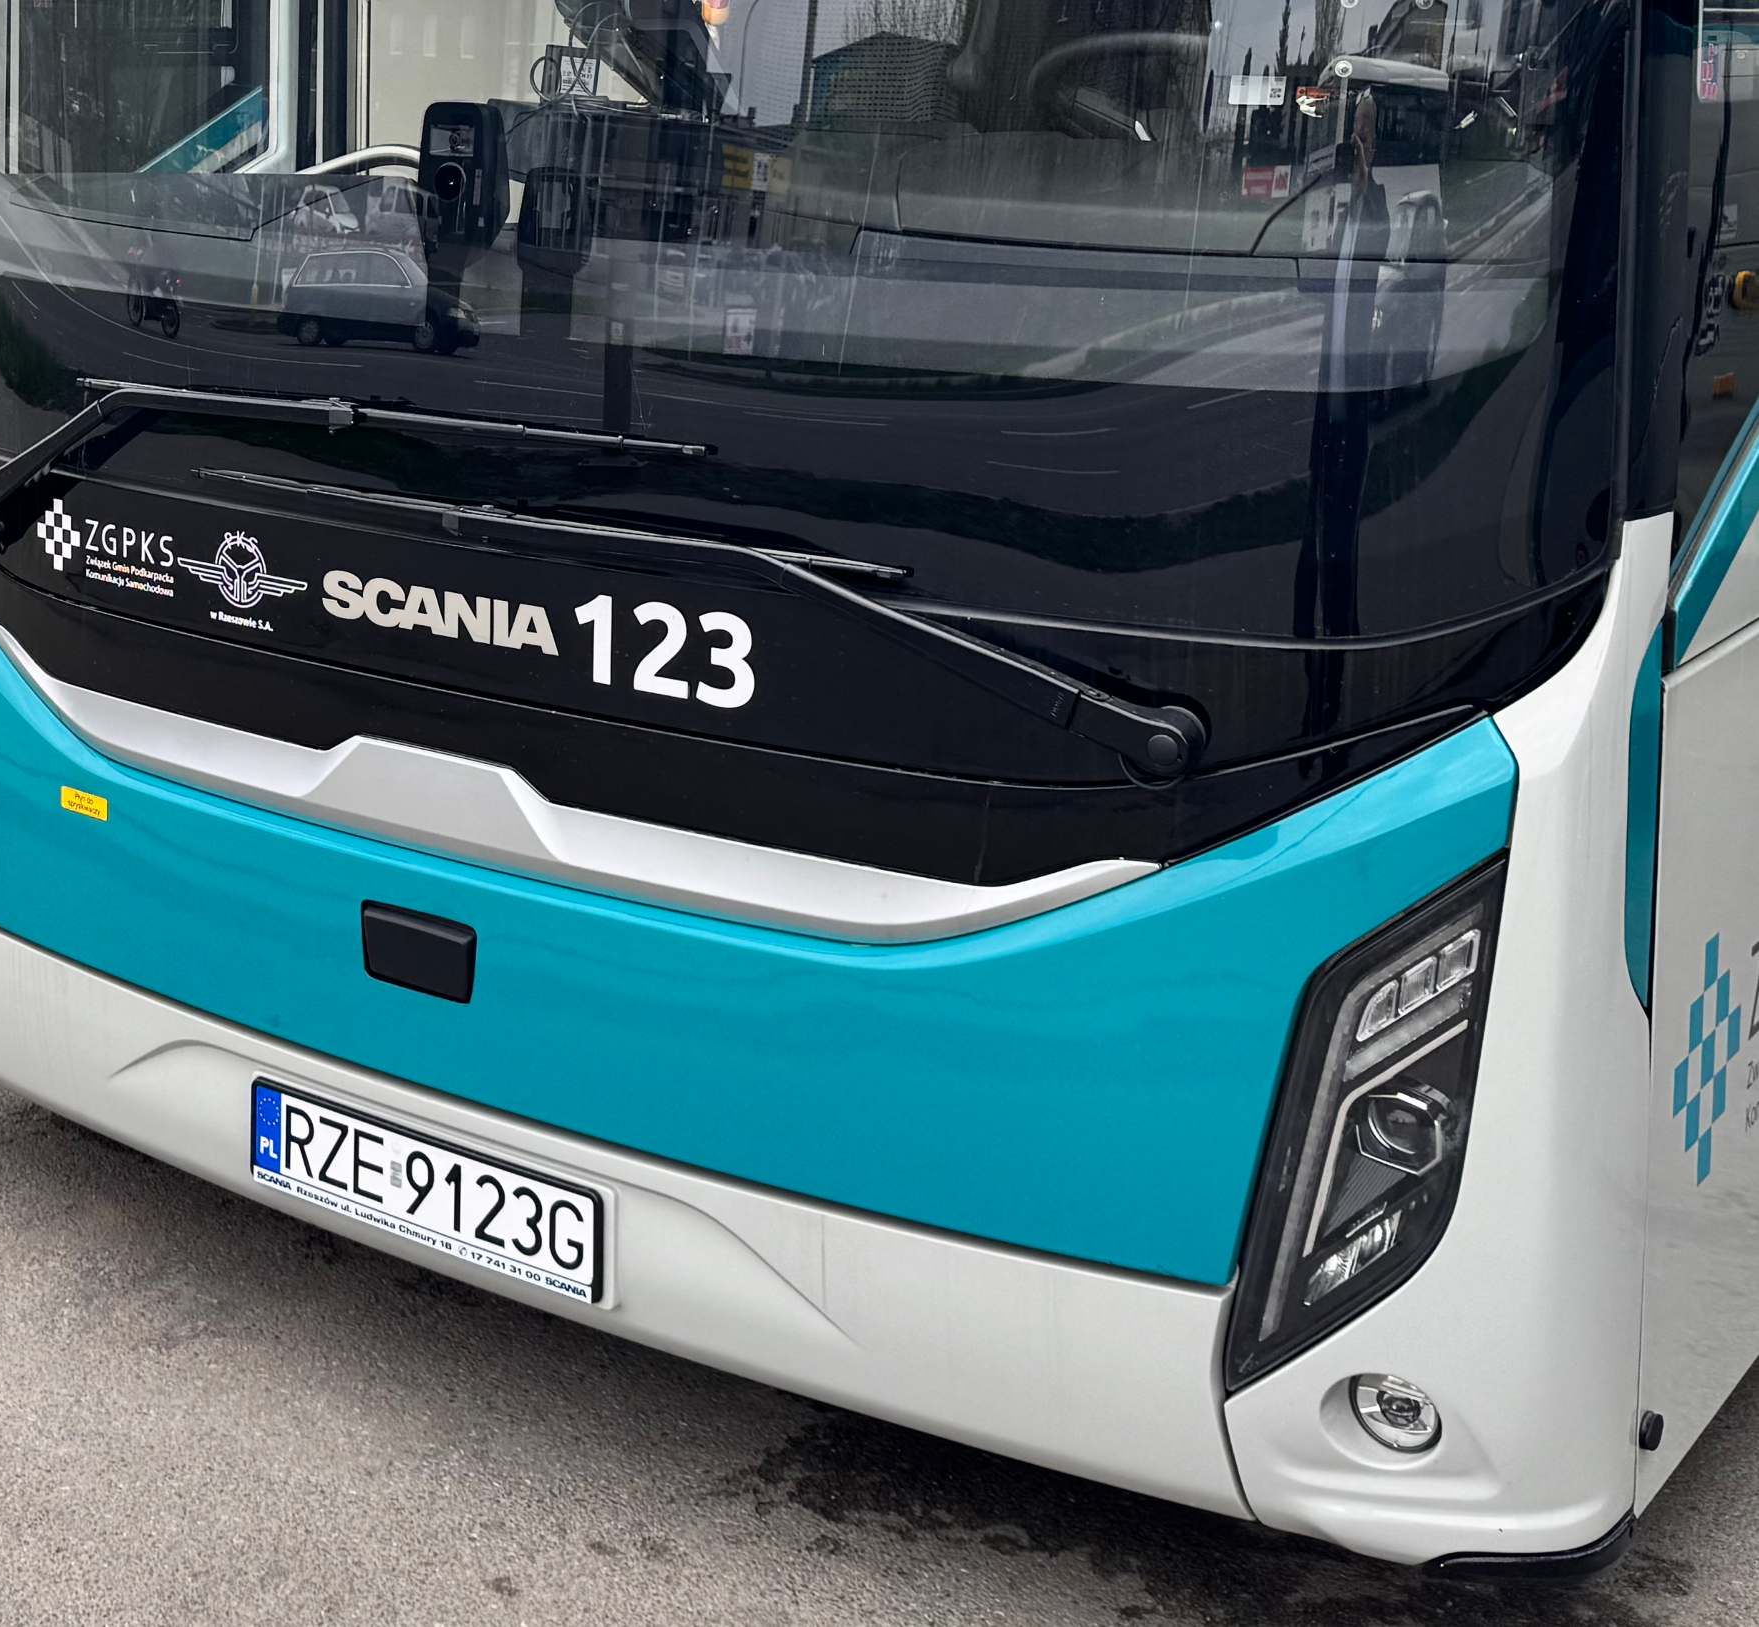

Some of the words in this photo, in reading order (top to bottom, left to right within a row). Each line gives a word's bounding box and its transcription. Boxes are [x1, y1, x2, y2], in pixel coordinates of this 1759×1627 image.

[84, 518, 174, 568] ZGPKS
[125, 577, 174, 598] Samochodowa
[130, 565, 175, 584] Podkarpacka
[322, 569, 560, 657] SCANIA
[573, 594, 756, 709] 123
[259, 1135, 279, 1160] PL
[285, 1103, 385, 1204] RZE
[405, 1150, 585, 1271] 9123G
[256, 1170, 292, 1191] SCANIA
[296, 1186, 338, 1208] Rzeszów
[340, 1204, 352, 1214] ul.
[354, 1207, 396, 1230] Ludwika
[398, 1224, 437, 1246] Chmury
[470, 1251, 483, 1261] 17
[485, 1256, 506, 1271] 741
[509, 1264, 522, 1276] 31
[525, 1270, 541, 1282] 00
[545, 1276, 587, 1298] SCANIA
